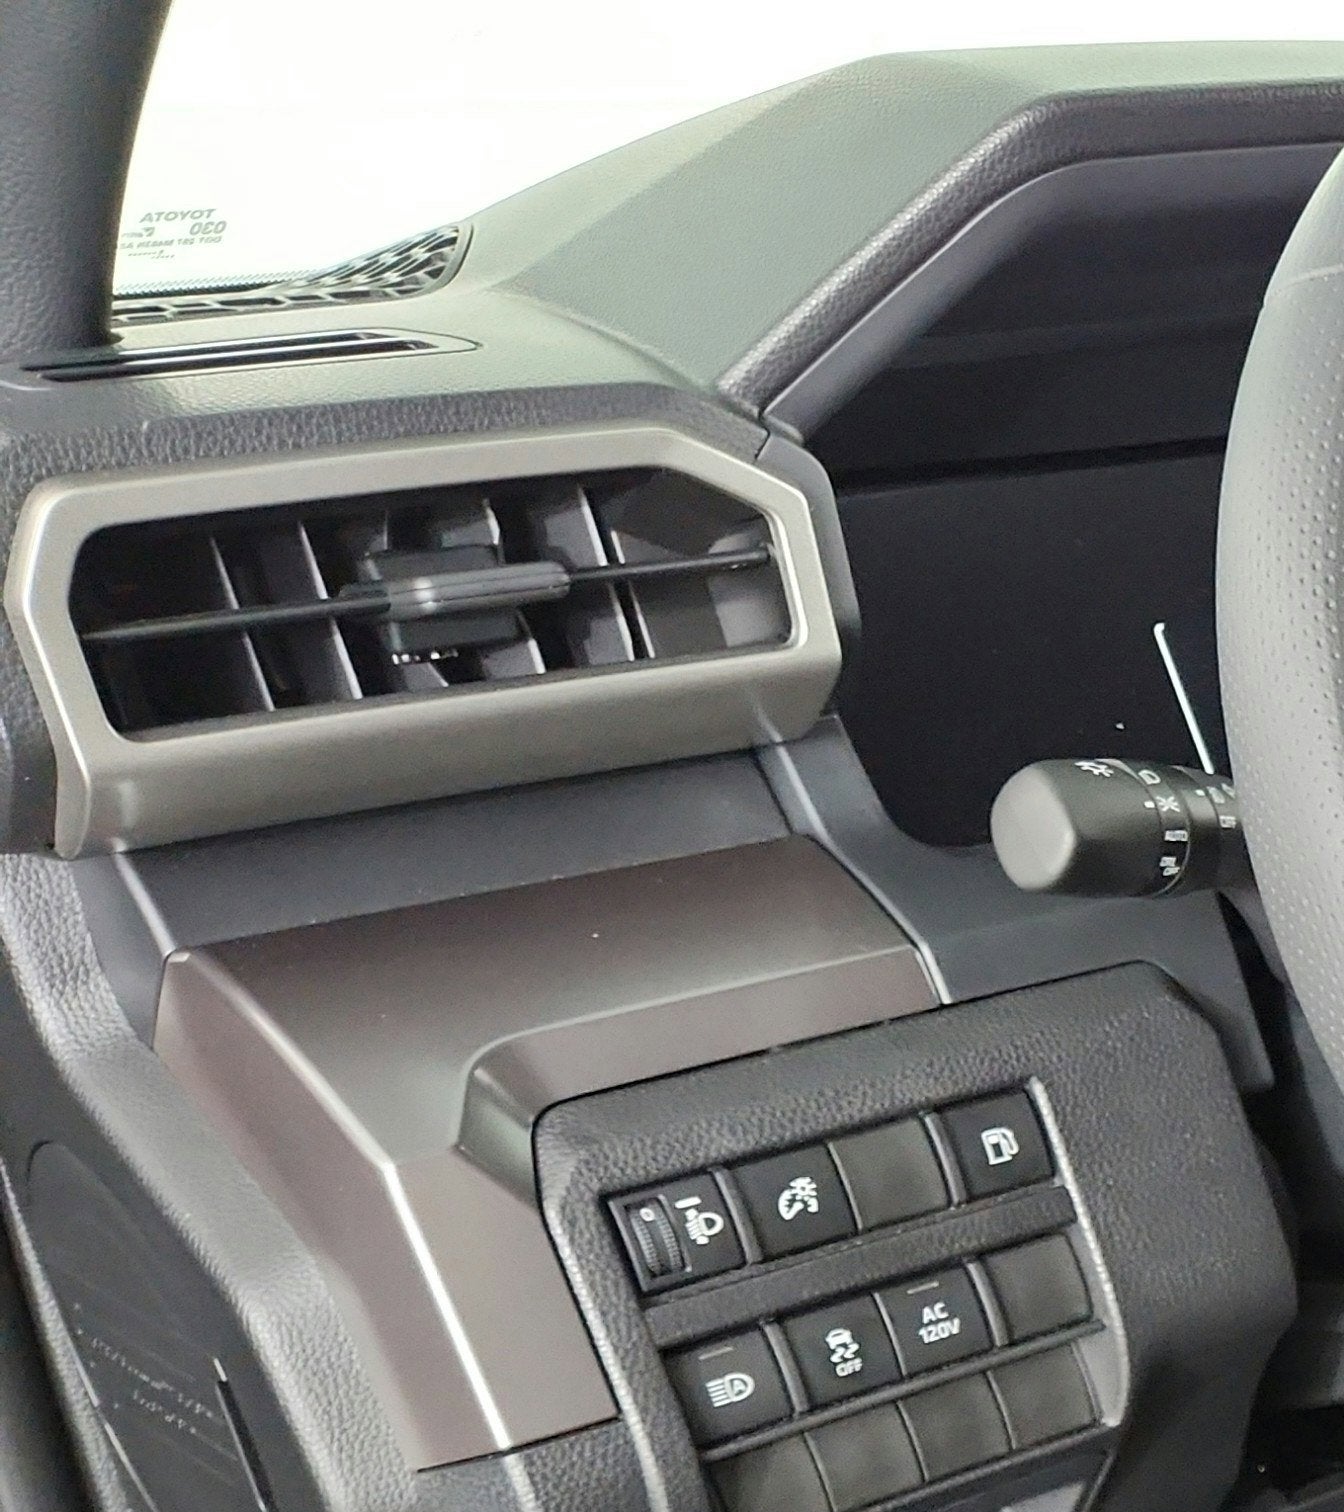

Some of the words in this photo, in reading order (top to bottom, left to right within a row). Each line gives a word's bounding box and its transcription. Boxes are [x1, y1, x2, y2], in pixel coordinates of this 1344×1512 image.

[921, 1302, 949, 1324] AC
[918, 1317, 961, 1344] 120V
[835, 1358, 863, 1377] OFF
